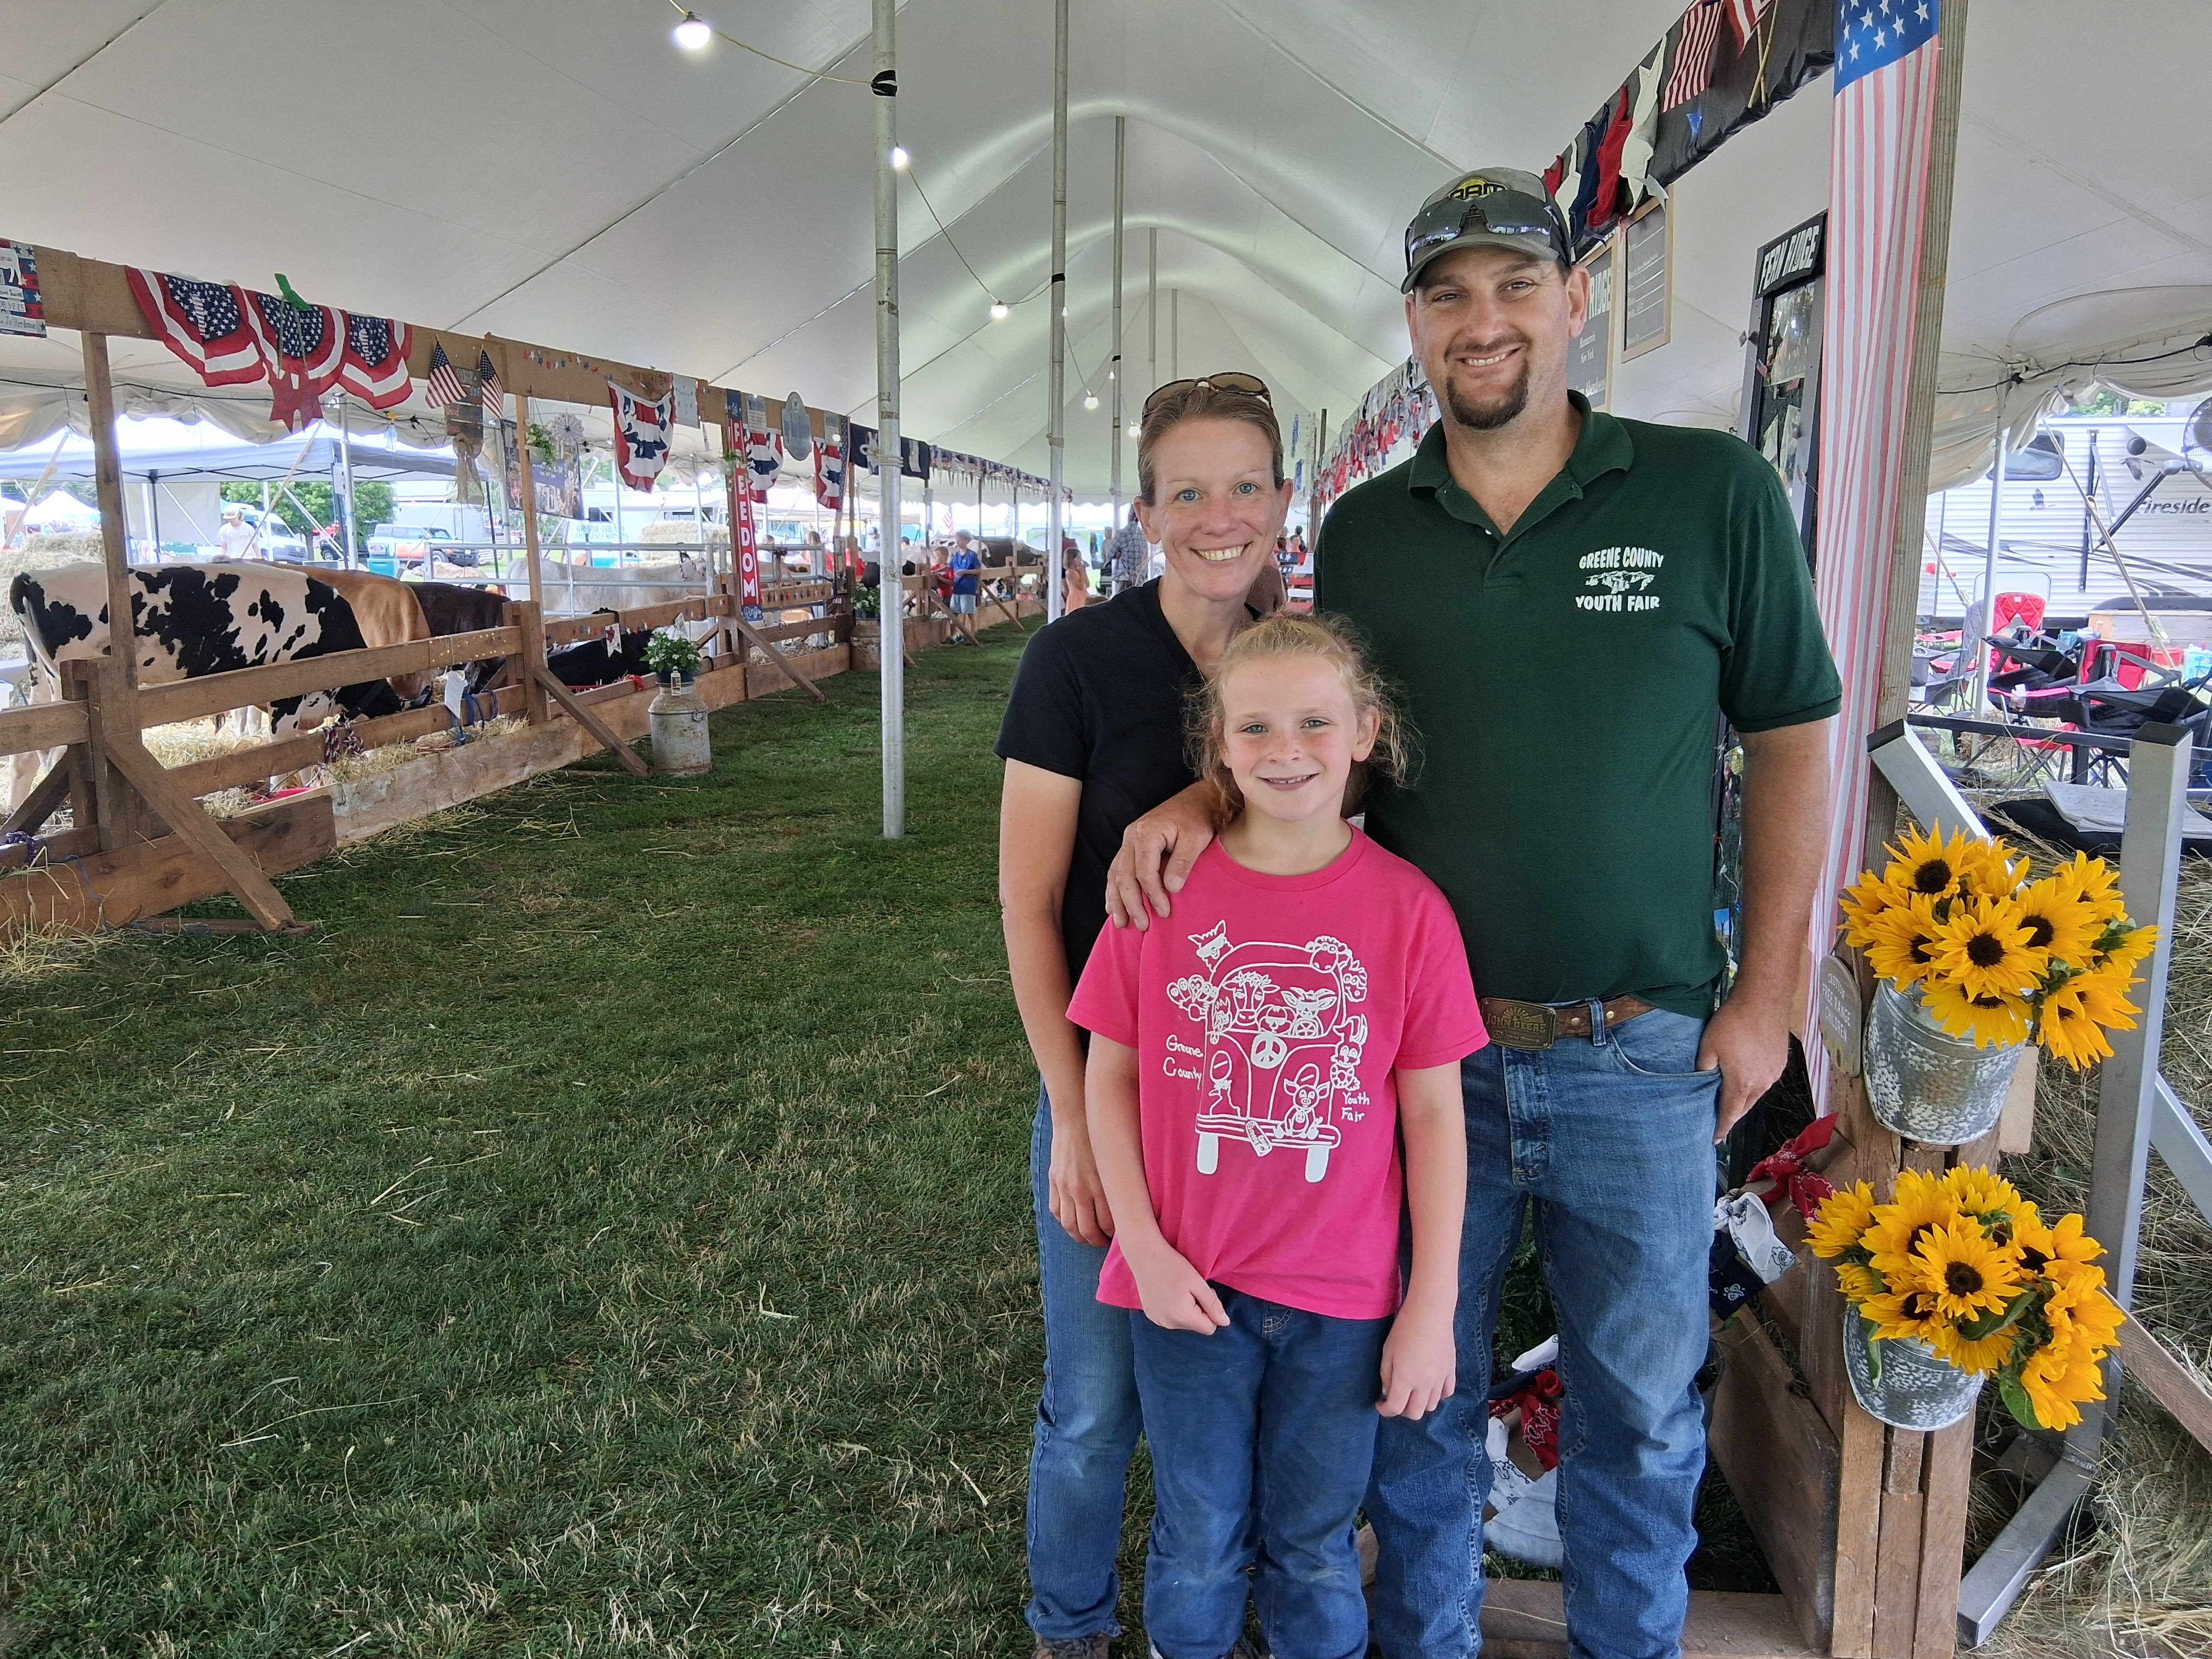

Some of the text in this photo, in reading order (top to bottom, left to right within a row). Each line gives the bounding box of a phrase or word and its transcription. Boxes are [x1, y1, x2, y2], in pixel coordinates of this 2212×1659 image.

[1758, 225, 1819, 294] FERN RIDGE
[1579, 546, 1664, 569] GREENE COUNTY
[1575, 594, 1660, 612] YOUTH FAIR
[1822, 982, 1851, 1027] FREE RANGE
[1486, 1013, 1511, 1026] JOHN
[1514, 1021, 1546, 1033] DEERE
[1166, 1034, 1204, 1058] Greene
[1162, 1056, 1202, 1091] County
[1342, 1091, 1370, 1105] Youth
[1341, 1107, 1365, 1122] Fair
